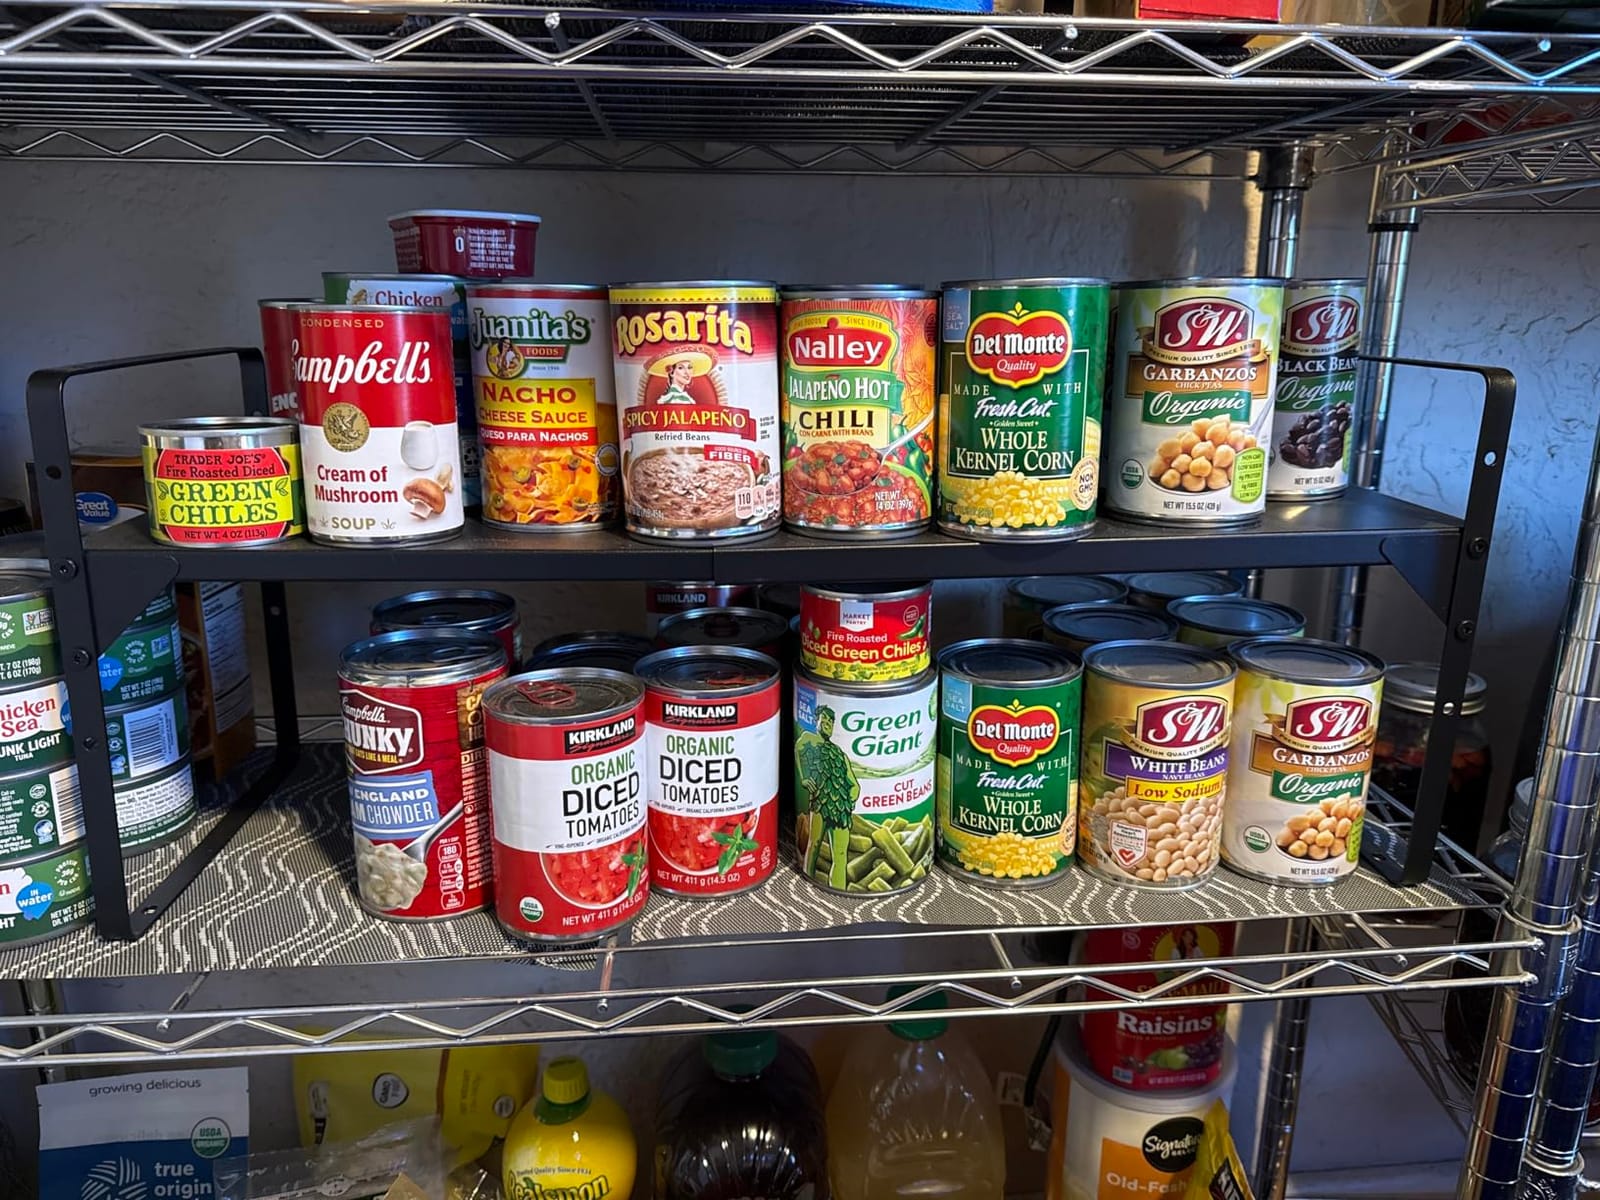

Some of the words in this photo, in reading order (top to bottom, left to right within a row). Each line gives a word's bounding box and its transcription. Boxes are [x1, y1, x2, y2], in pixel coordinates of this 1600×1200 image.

[375, 291, 443, 307] Chicken
[301, 319, 384, 328] CONDENSED
[946, 321, 964, 330] SALT
[947, 312, 962, 320] SEA
[1164, 304, 1245, 347] S&W
[1295, 302, 1354, 340] S&W
[472, 308, 589, 349] Juanita's
[616, 305, 753, 353] Rosarita
[526, 347, 559, 356] FOODS
[795, 334, 883, 364] Nalley
[973, 334, 1000, 355] Del
[1004, 334, 1066, 355] Monte
[1181, 354, 1215, 362] QUALITY
[1216, 348, 1237, 358] SINCE
[997, 358, 1036, 373] Quality
[1143, 364, 1257, 381] GARBANZOS
[483, 382, 577, 404] NACHO
[855, 377, 890, 400] HOT
[954, 384, 990, 395] MADE
[1043, 382, 1081, 395] WITH
[1276, 374, 1354, 410] Organic
[480, 407, 525, 423] CHEESE
[532, 411, 588, 424] SAUCE
[974, 397, 1017, 418] Fresh
[1150, 391, 1246, 424] Organic
[627, 411, 658, 427] SPICY
[664, 409, 746, 428] JALAPEÑO
[799, 410, 874, 430] CHILI
[480, 428, 503, 440] QUESO
[507, 432, 536, 441] PARA
[540, 432, 588, 442] NACHOS
[655, 433, 682, 441] Refried
[686, 433, 710, 441] Beans
[981, 428, 1048, 449] WHOLE
[175, 454, 222, 465] TRADER
[227, 454, 261, 464] JOE'S
[709, 451, 751, 463] FIBER
[956, 448, 1019, 471] KERNEL
[1024, 450, 1074, 471] CORN
[165, 465, 186, 477] Fire
[190, 467, 239, 478] Roasted
[243, 464, 275, 476] Diced
[317, 464, 366, 483] Cream
[369, 466, 387, 482] of
[1079, 475, 1093, 483] NON
[170, 480, 273, 502] GREEN
[315, 483, 398, 504] Mushroom
[739, 493, 750, 505] 110
[875, 492, 887, 500] NET
[77, 499, 109, 511] Great
[83, 509, 110, 518] Value
[170, 502, 278, 524] CHILES
[245, 528, 268, 538] (113g)
[332, 517, 376, 530] SOUP
[656, 593, 706, 604] KIRKLAND
[802, 632, 828, 655] Diced
[832, 644, 879, 660] Green
[883, 641, 921, 658] Chiles
[827, 631, 845, 641] Fire
[846, 633, 888, 643] Roasted
[100, 668, 123, 677] ater
[799, 701, 813, 714] SEA
[946, 701, 966, 713] SALT
[948, 693, 964, 705] SEA
[0, 698, 56, 721] hicken
[665, 703, 736, 718] KIRKLAND
[799, 711, 814, 725] SALT
[1, 717, 39, 738] Sea
[841, 709, 921, 732] Green
[975, 719, 1001, 739] Del
[1003, 722, 1054, 740] Monte
[1148, 702, 1223, 743] S&W
[1295, 702, 1365, 738] S&W
[344, 717, 414, 756] HUNKY
[568, 717, 635, 745] KIRKLAND
[0, 742, 25, 758] UNK
[28, 732, 61, 751] LIGHT
[666, 734, 735, 756] ORGANIC
[852, 731, 923, 757] Giant
[997, 742, 1032, 755] Quality
[1130, 739, 1165, 756] PREMIUM
[1167, 748, 1198, 757] QUALITY
[1200, 741, 1217, 752] SINCE
[1279, 733, 1310, 750] PREMIUM
[1312, 742, 1341, 750] QUALITY
[14, 752, 34, 761] TUNA
[955, 753, 992, 771] MADE
[1037, 756, 1067, 771] WITH
[1130, 755, 1187, 774] WHITE
[1190, 753, 1226, 772] BEANS
[1273, 747, 1370, 767] GARBANZOS
[571, 749, 636, 785] ORGANIC
[660, 755, 742, 784] DICED
[1184, 772, 1205, 780] BEANS
[894, 779, 915, 792] CUT
[976, 772, 1016, 789] Fresh
[1133, 784, 1168, 799] Low
[1175, 780, 1220, 799] Sodium
[1279, 773, 1361, 802] Organic
[354, 789, 429, 802] ENGLAND
[562, 771, 640, 817] DICED
[661, 783, 739, 805] TOMATOES
[862, 791, 905, 808] GREEN
[906, 780, 932, 802] BEANS
[352, 803, 366, 822] AM
[367, 801, 435, 825] CHOWDER
[983, 795, 1042, 816] WHOLE
[565, 800, 640, 839] TOMATOES
[959, 806, 1019, 834] KERNEL
[1022, 811, 1062, 832] CORN
[443, 845, 457, 855] 180
[657, 871, 670, 881] NET
[671, 872, 684, 883] WT
[685, 874, 697, 884] 411
[700, 877, 706, 887] g
[707, 873, 727, 886] (14.5
[728, 872, 741, 883] OZ)
[18, 891, 53, 908] water
[30, 889, 38, 897] IN
[51, 910, 62, 919] NET
[78, 900, 85, 909] OZ
[524, 901, 538, 910] USDA
[562, 915, 581, 927] NET
[582, 911, 596, 924] WT
[598, 908, 611, 920] 411
[612, 906, 619, 917] g
[619, 899, 635, 918] (14.5
[1117, 1011, 1212, 1035] Raisins
[89, 1081, 143, 1098] growing
[146, 1078, 202, 1091] delicious
[380, 1081, 391, 1103] GMO
[199, 1127, 222, 1137] USDA
[1145, 1133, 1200, 1159] Signatu
[154, 1162, 195, 1178] true
[154, 1180, 213, 1199] origin
[1106, 1171, 1187, 1194] Old-Fash
